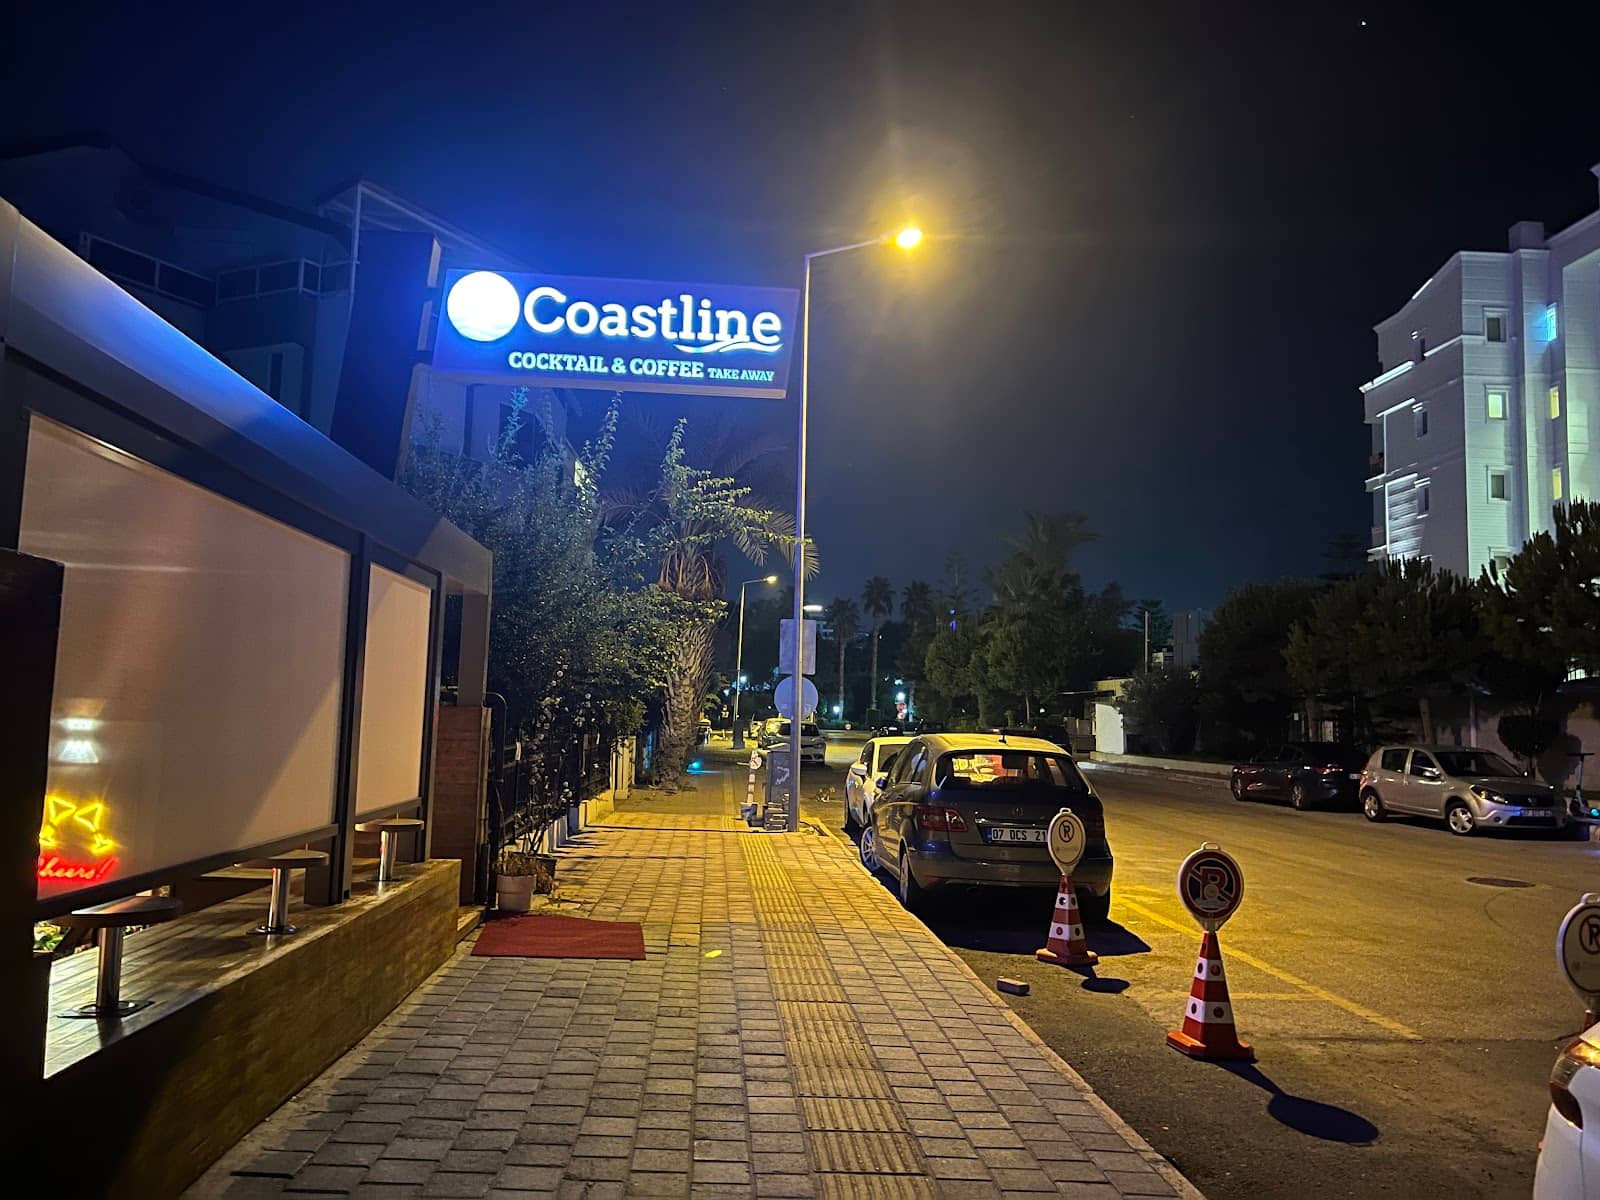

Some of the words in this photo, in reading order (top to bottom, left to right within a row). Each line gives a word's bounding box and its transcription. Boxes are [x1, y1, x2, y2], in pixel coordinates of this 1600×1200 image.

[523, 286, 782, 345] Coastline
[508, 351, 609, 373] COCKTAIL
[611, 357, 627, 374] &
[629, 358, 704, 378] COFFEE
[707, 367, 739, 380] TAKE
[740, 369, 775, 382] AWAY
[992, 829, 1004, 840] 07
